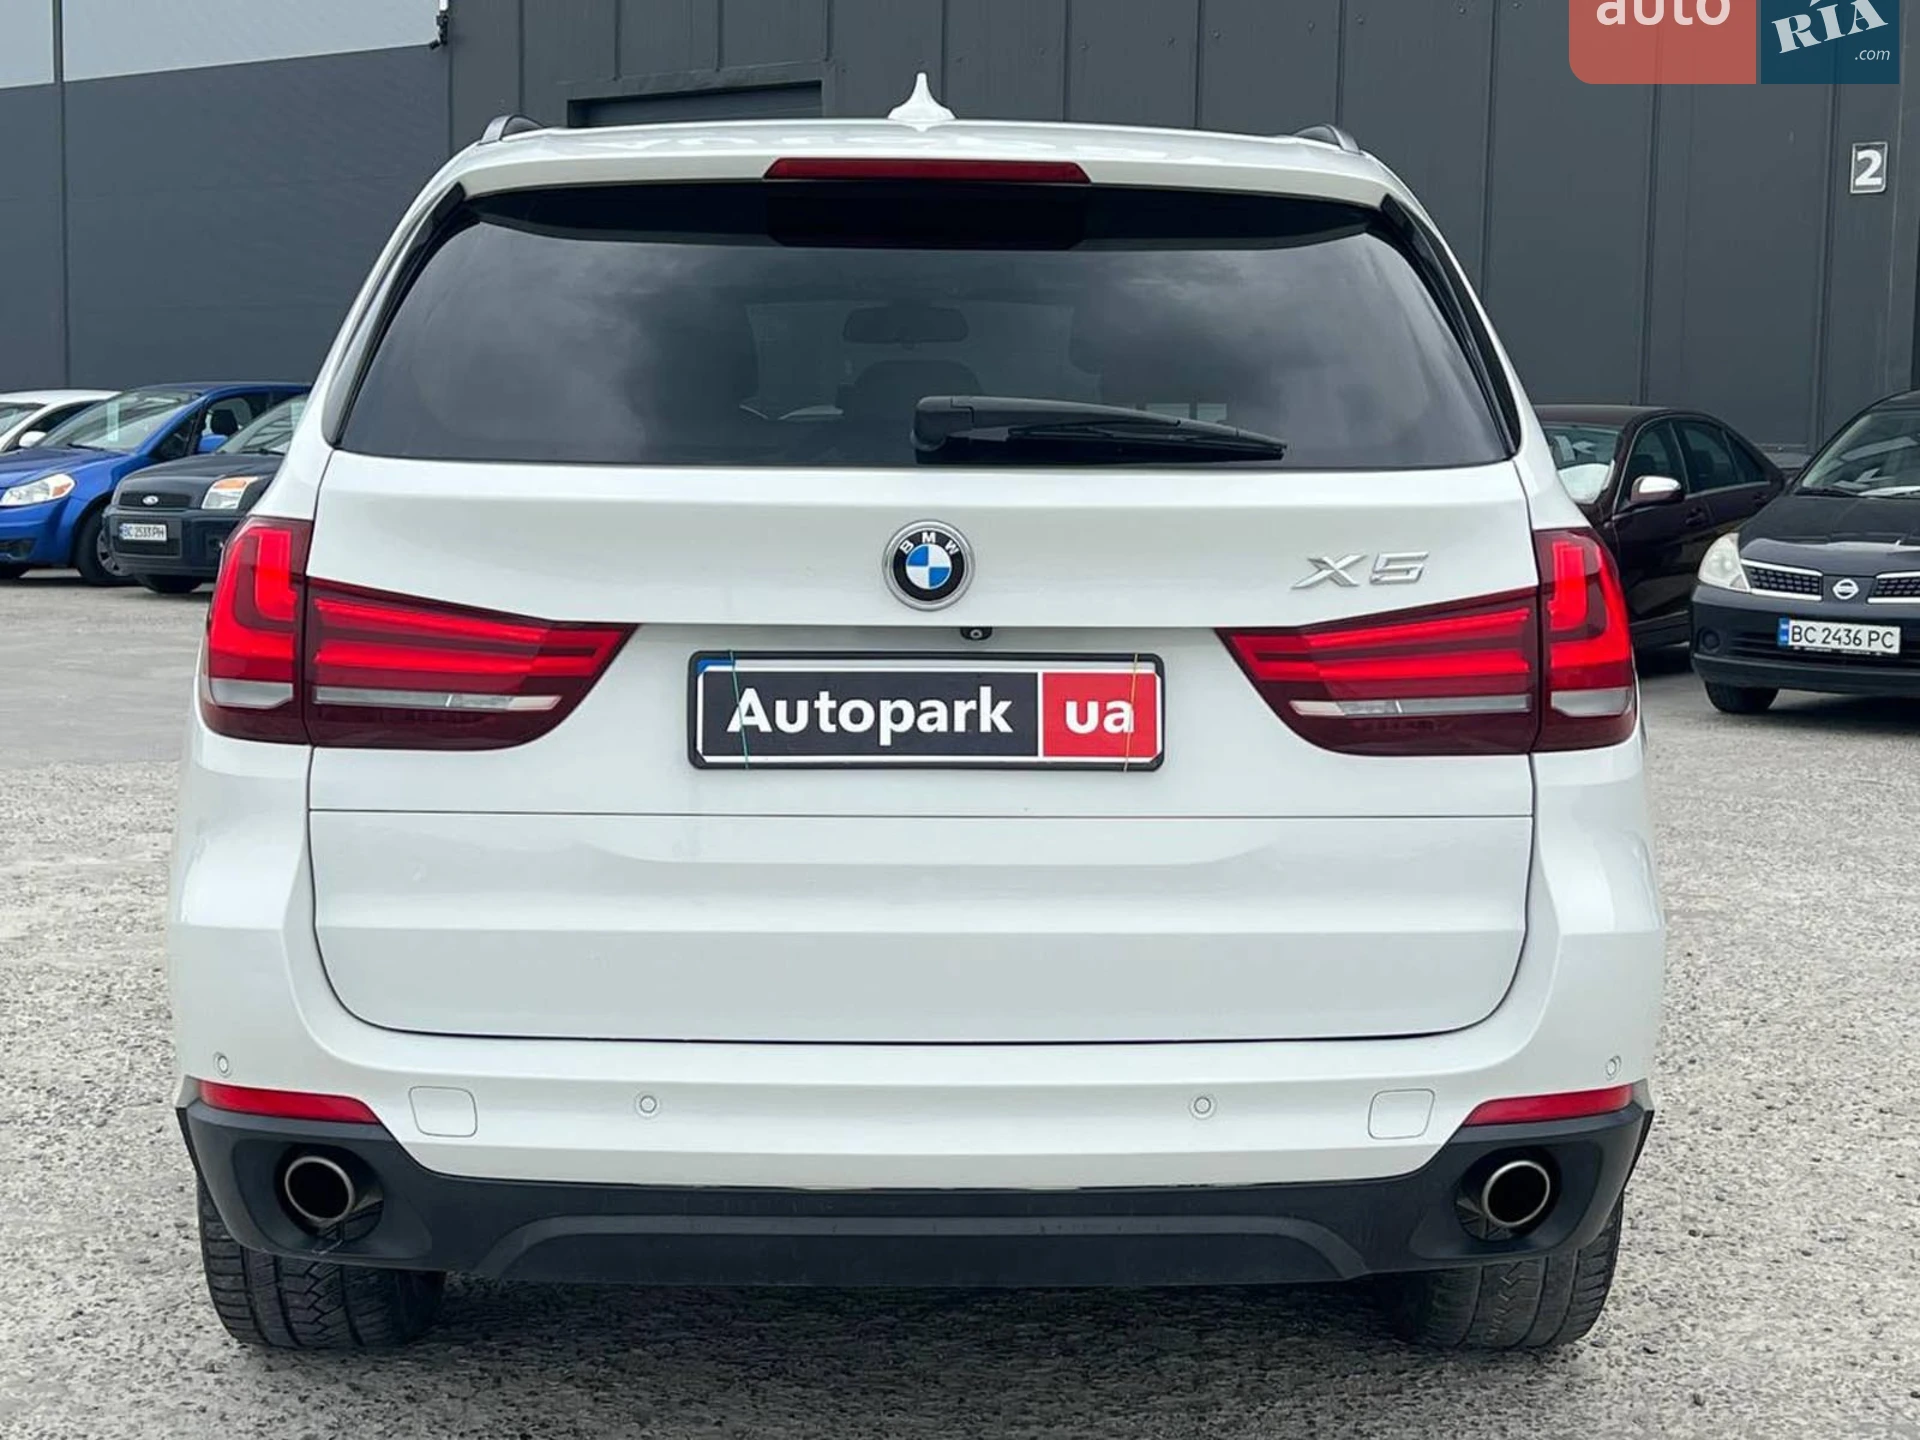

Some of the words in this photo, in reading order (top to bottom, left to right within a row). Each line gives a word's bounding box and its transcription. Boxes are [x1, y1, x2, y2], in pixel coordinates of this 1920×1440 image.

[1854, 149, 1883, 187] 2
[899, 531, 960, 555] BMW
[1290, 551, 1429, 590] X5
[1792, 625, 1817, 643] BC
[1821, 627, 1863, 647] 2436
[1867, 630, 1895, 649] PC
[727, 686, 1013, 746] Autopark
[1065, 699, 1134, 734] ua
